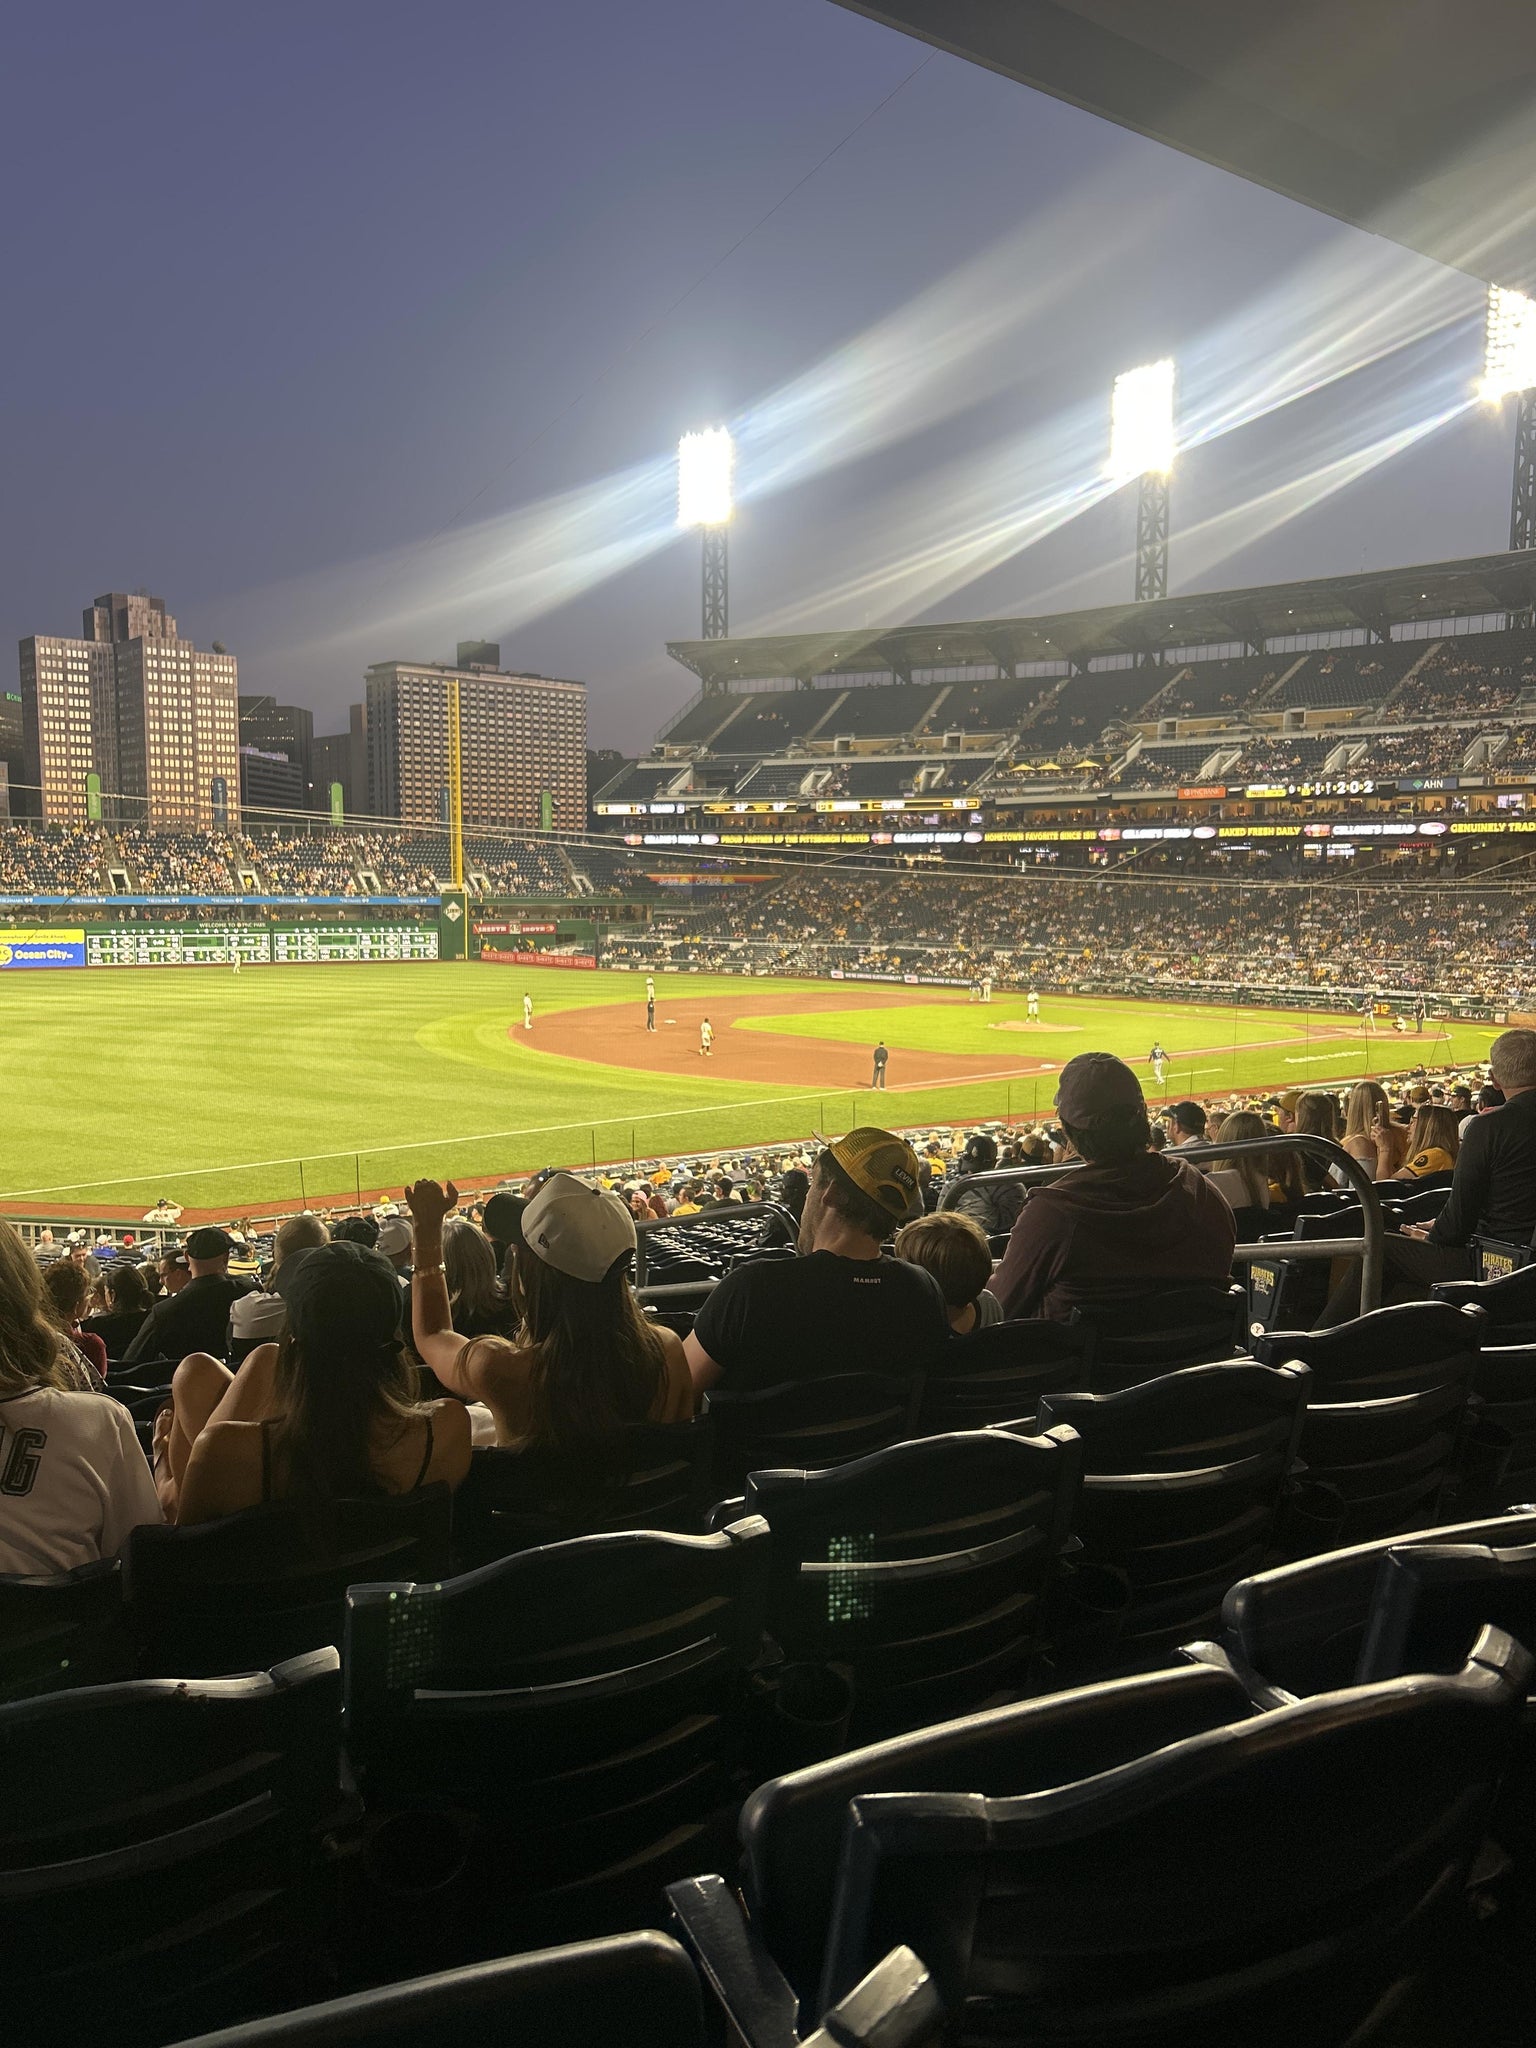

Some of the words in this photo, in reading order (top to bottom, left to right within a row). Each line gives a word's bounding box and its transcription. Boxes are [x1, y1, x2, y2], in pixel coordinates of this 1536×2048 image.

[1363, 780, 1374, 794] 2
[1423, 780, 1444, 789] AHN
[1219, 827, 1247, 837] BAKED
[1247, 827, 1275, 837] FRESH
[1276, 826, 1301, 836] DAILY
[1450, 823, 1506, 833] GENUINELY
[720, 834, 743, 844] PROUD
[744, 834, 773, 844] PARTNER
[799, 833, 840, 843] PITTSBURGH
[841, 833, 869, 843] PIRATES
[984, 831, 1024, 841] HOMETOWN
[1025, 830, 1059, 841] FAVORITE
[1060, 830, 1082, 840] SINCE
[15, 950, 46, 959] Ocean
[47, 949, 68, 960] City
[895, 1168, 915, 1186] LEVIN
[1482, 1251, 1513, 1273] PIRATES
[1251, 1265, 1275, 1287] PIRATES
[0, 1426, 48, 1497] 6
